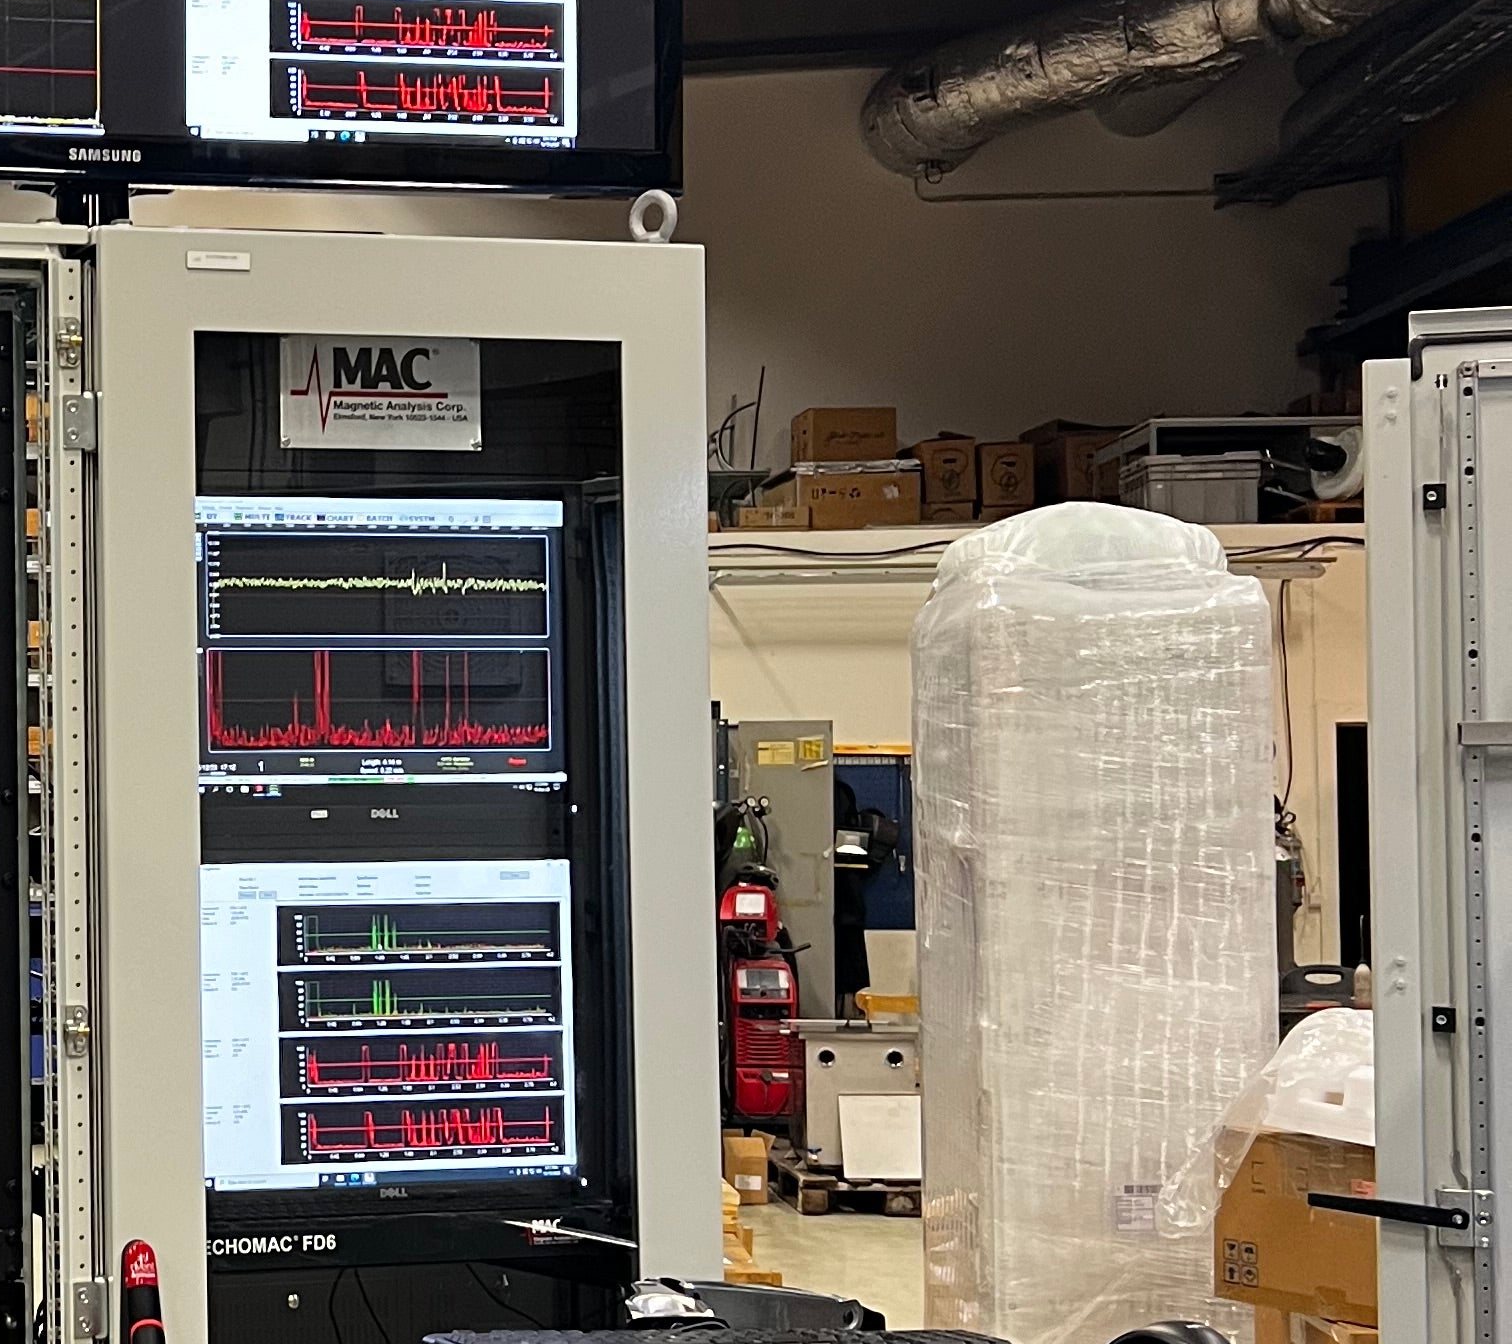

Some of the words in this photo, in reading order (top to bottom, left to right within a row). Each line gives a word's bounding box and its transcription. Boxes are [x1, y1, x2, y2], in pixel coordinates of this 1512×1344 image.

[69, 148, 141, 162] SAMSUNG
[333, 347, 432, 390] MAC
[333, 401, 383, 411] Magnetic
[387, 401, 432, 412] Analysis
[436, 402, 467, 413] Corp.
[257, 761, 264, 772] 1
[371, 809, 399, 819] DELL
[380, 1188, 408, 1198] DELL
[302, 1235, 336, 1251] FD6
